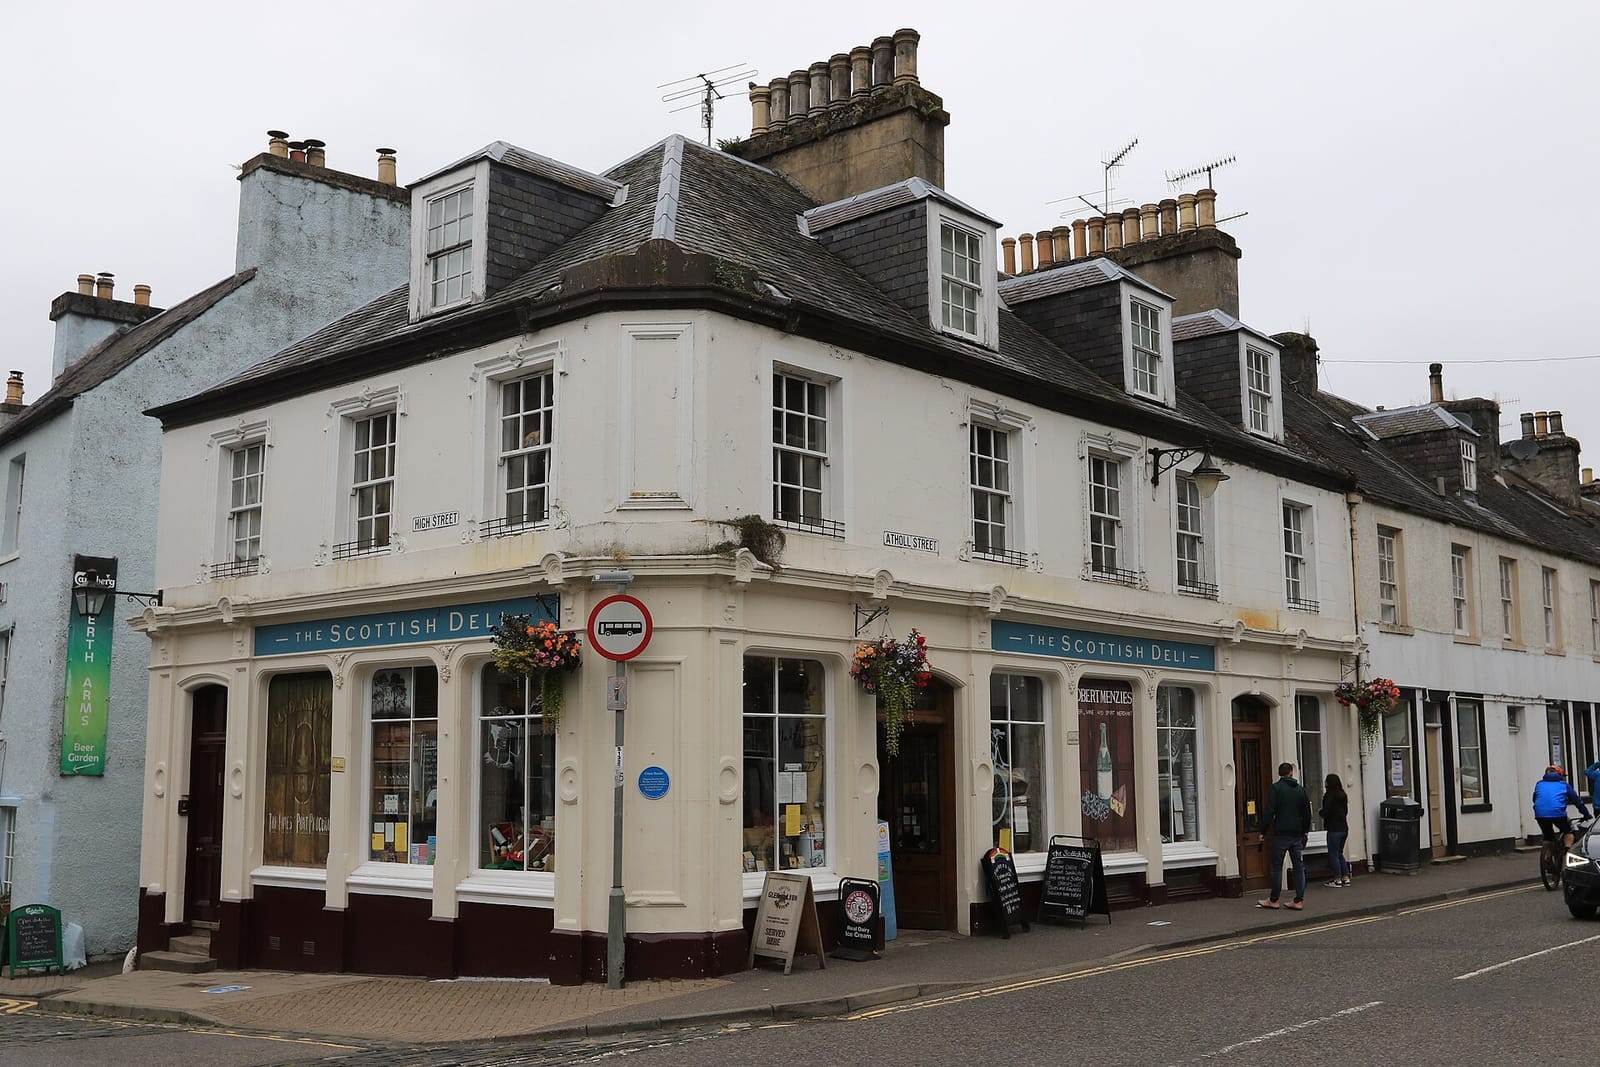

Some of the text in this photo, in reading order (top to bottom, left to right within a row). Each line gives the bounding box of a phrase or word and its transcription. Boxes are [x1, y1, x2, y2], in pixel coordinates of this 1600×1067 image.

[414, 512, 458, 530] HIGH STREET
[885, 533, 937, 551] ATHOLL STREET
[74, 571, 115, 589] Carberg
[84, 615, 96, 663] ERTH
[295, 630, 323, 643] THE
[1028, 634, 1055, 647] THE
[80, 677, 93, 726] ARMS
[1077, 688, 1133, 705] OBERT MENZIES
[73, 743, 95, 752] Beer
[67, 753, 100, 763] Garden
[764, 928, 786, 938] SERVED
[845, 930, 872, 939] Ice Cream
[857, 926, 870, 934] Dairy
[765, 937, 781, 946] HERE
